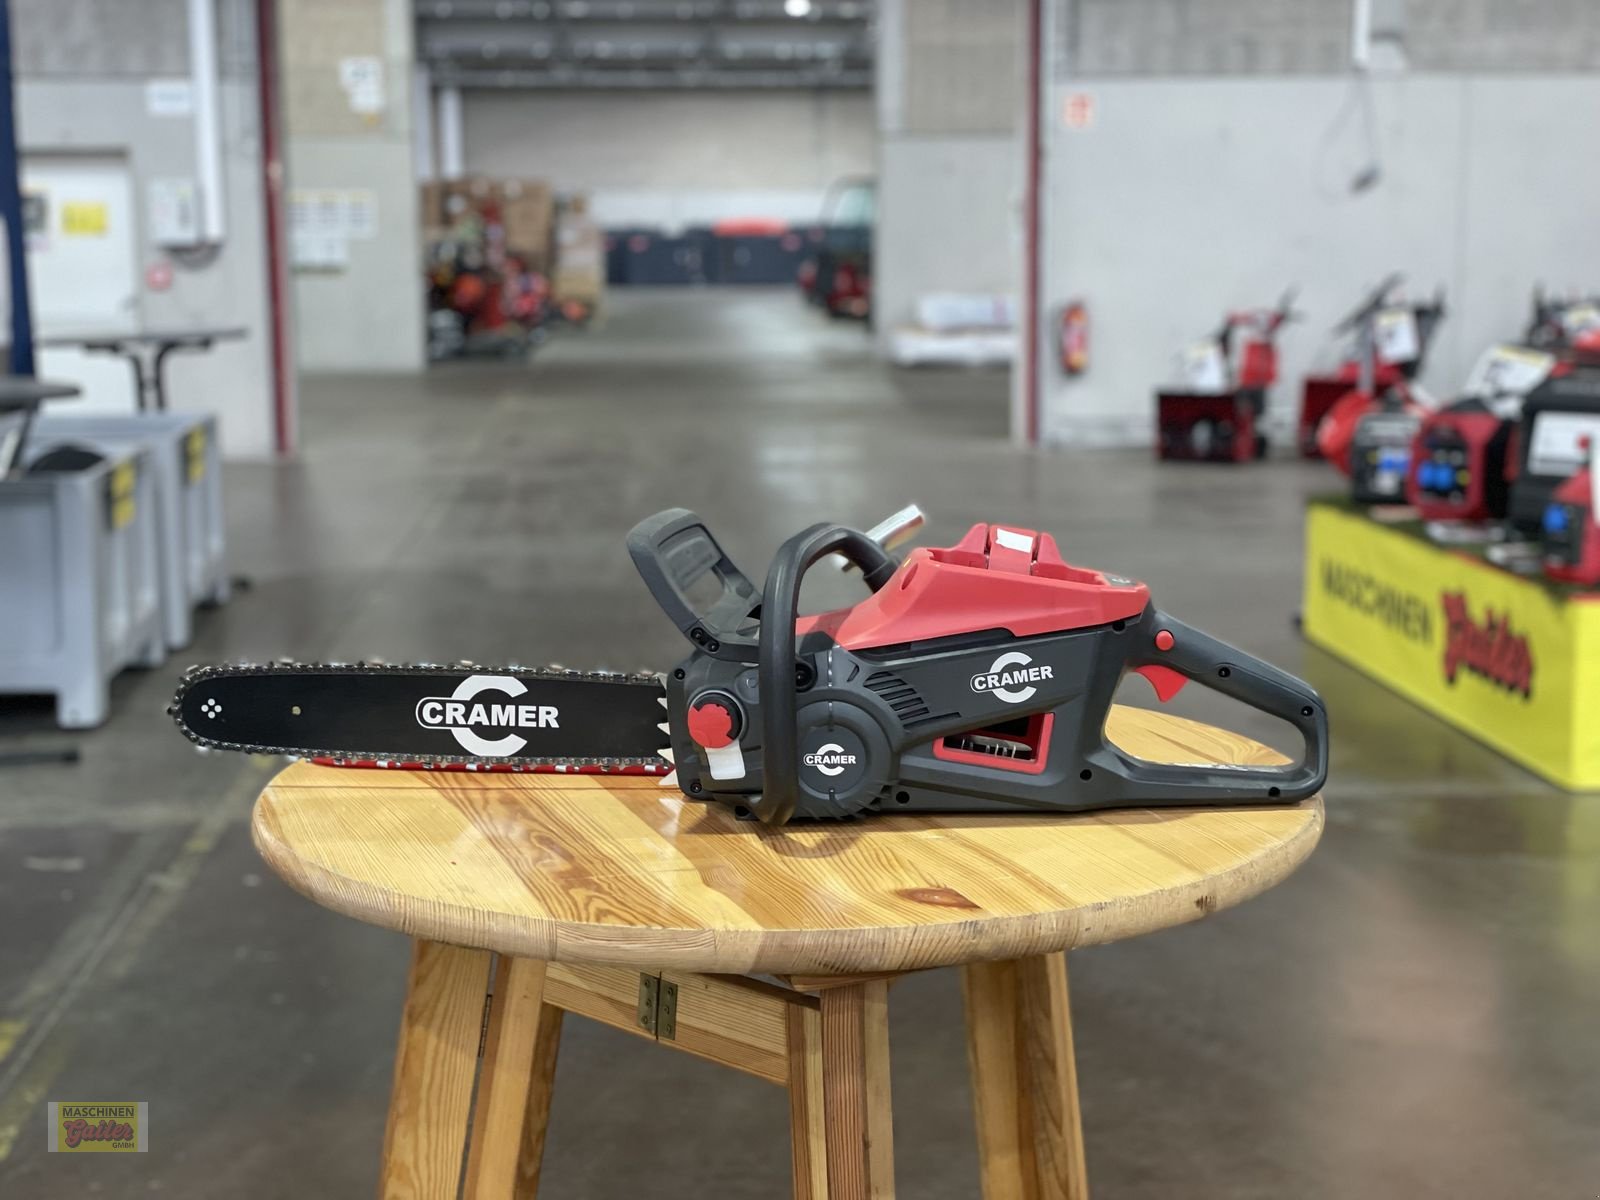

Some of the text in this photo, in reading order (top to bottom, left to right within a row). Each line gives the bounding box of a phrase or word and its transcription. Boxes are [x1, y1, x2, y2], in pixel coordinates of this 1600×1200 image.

[1320, 558, 1432, 643] MASCHINEN
[974, 665, 1054, 690] CRAMER
[422, 701, 560, 729] CRAMER
[805, 755, 857, 765] CRAMER
